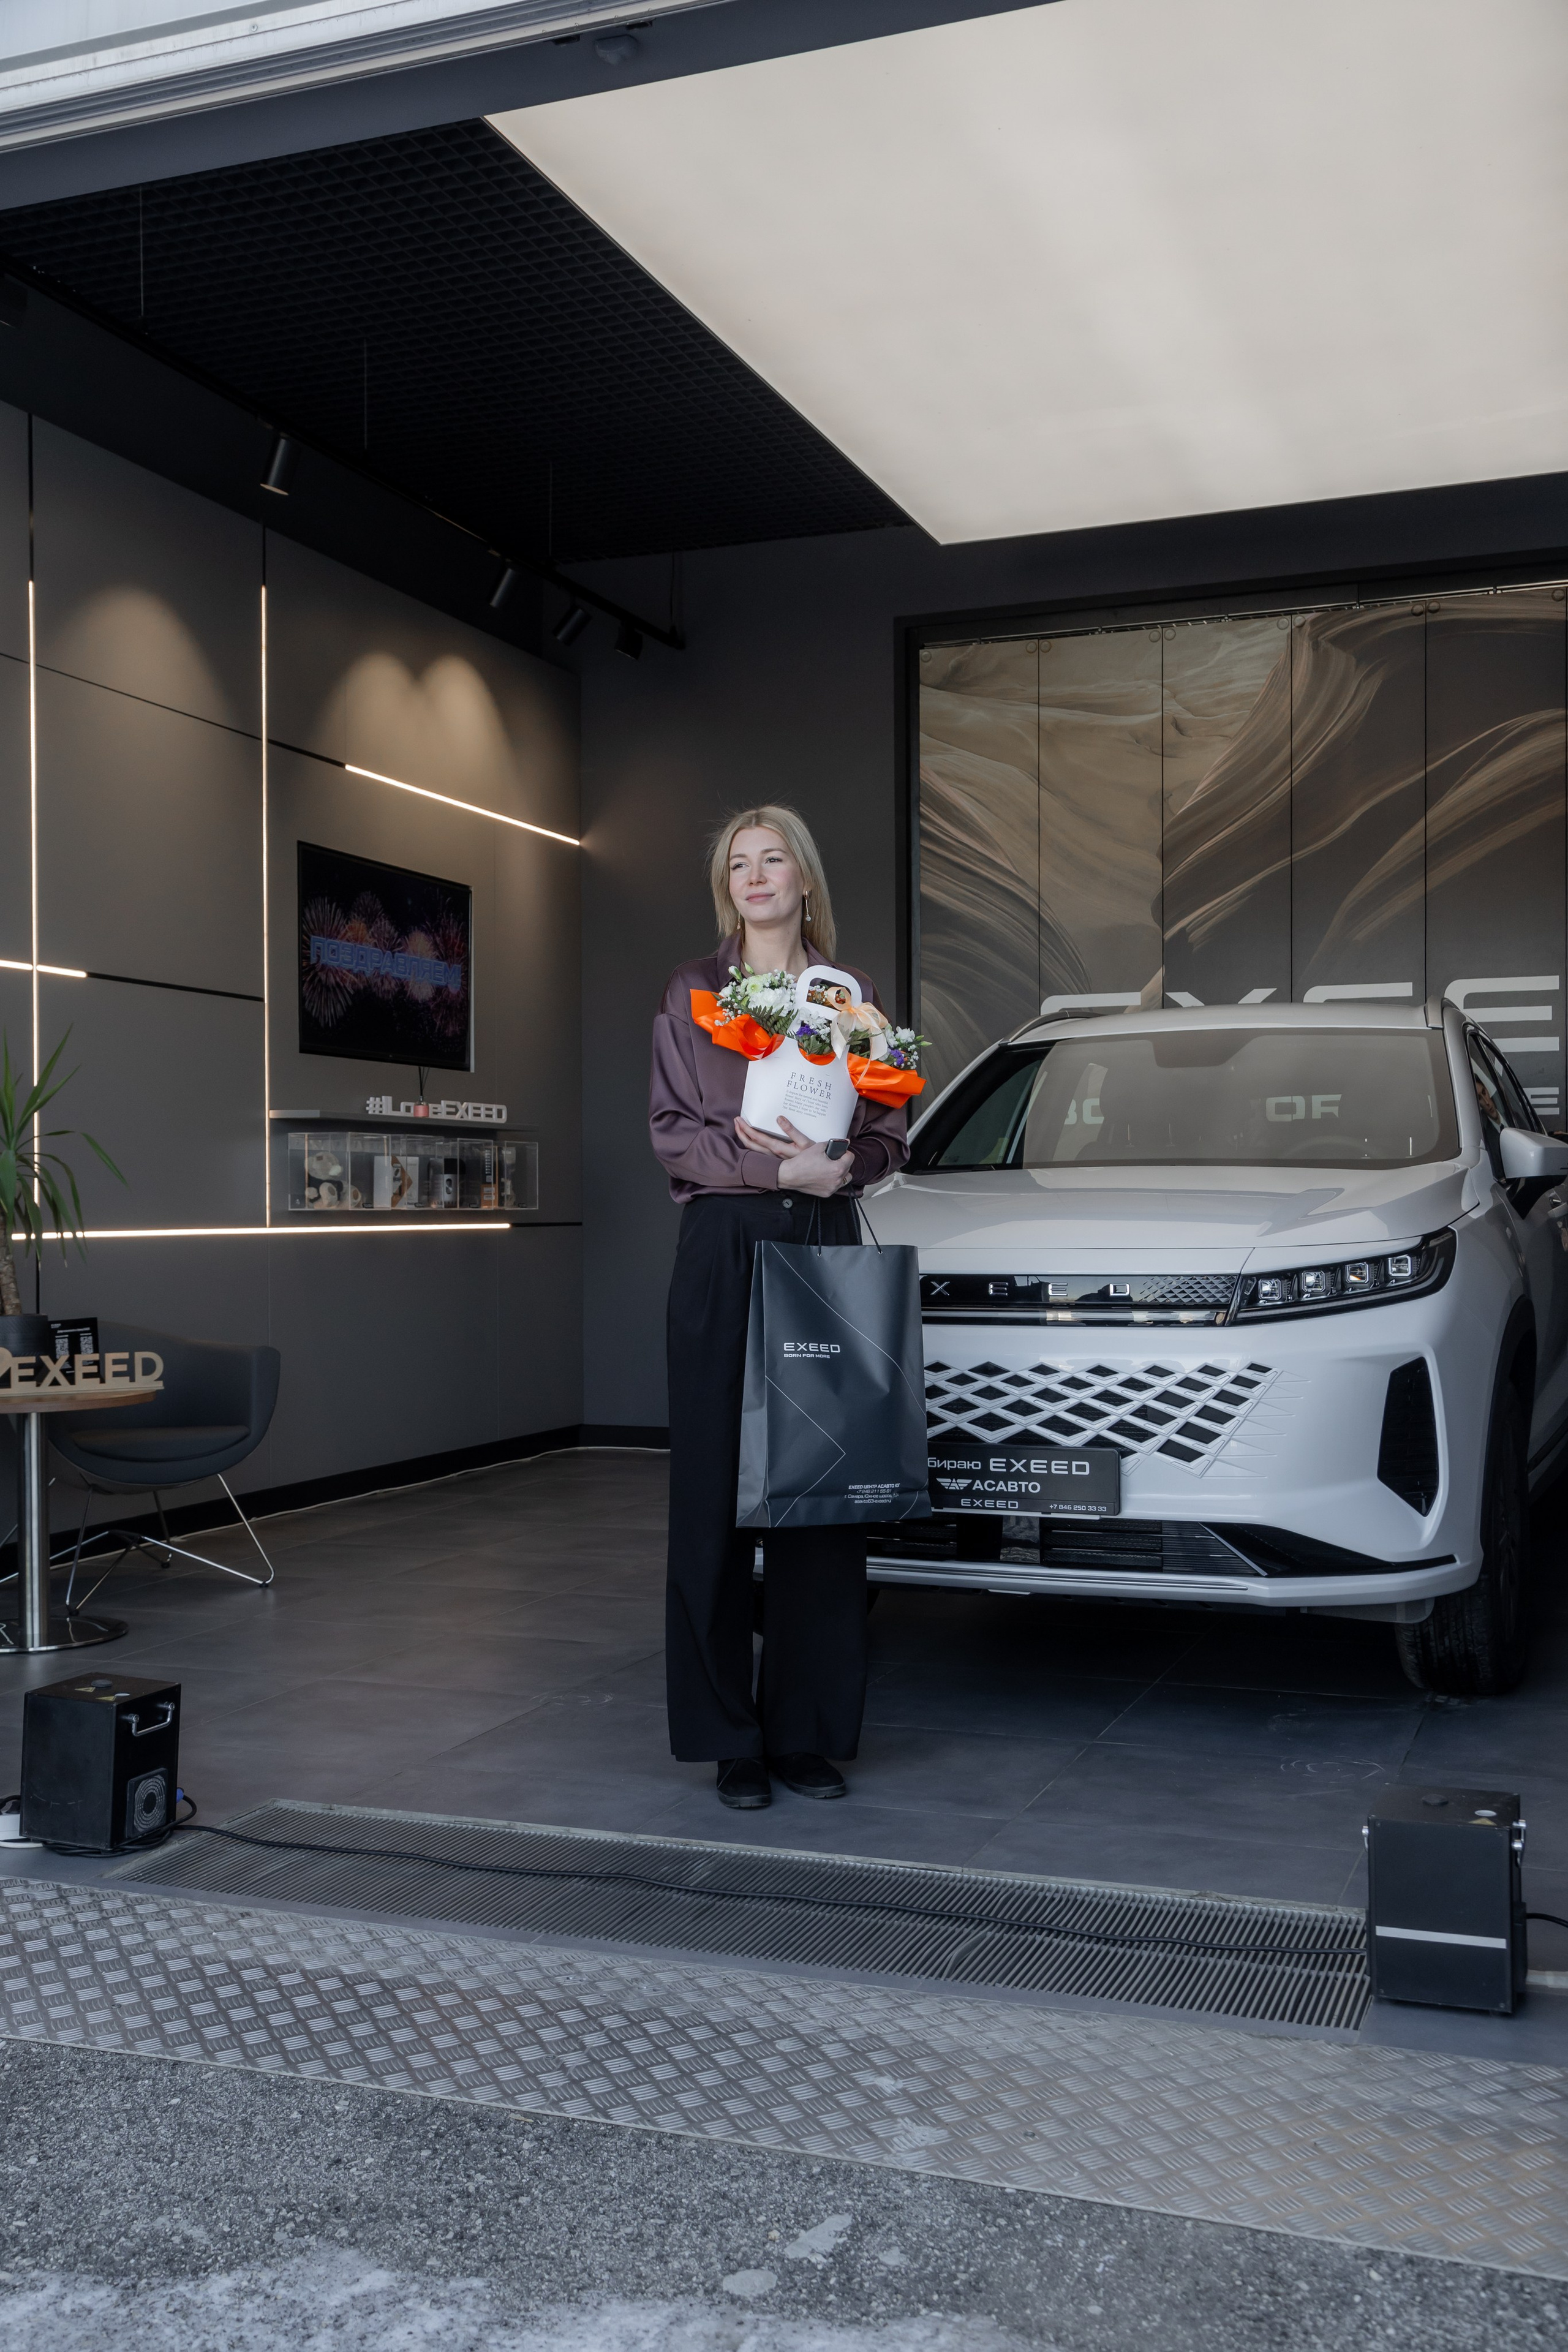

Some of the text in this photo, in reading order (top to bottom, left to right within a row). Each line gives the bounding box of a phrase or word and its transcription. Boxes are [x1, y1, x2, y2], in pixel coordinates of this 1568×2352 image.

[787, 1080, 831, 1099] FLOWER
[791, 1072, 832, 1090] FRESH
[366, 1095, 507, 1123] #LoeEXEED
[930, 1281, 1131, 1297] XEED
[783, 1342, 840, 1353] EXEED
[10, 1351, 164, 1389] EXEED
[927, 1457, 1090, 1476] бираю EXEED
[972, 1480, 1041, 1493] АСАВТО
[960, 1498, 1019, 1509] EXEED
